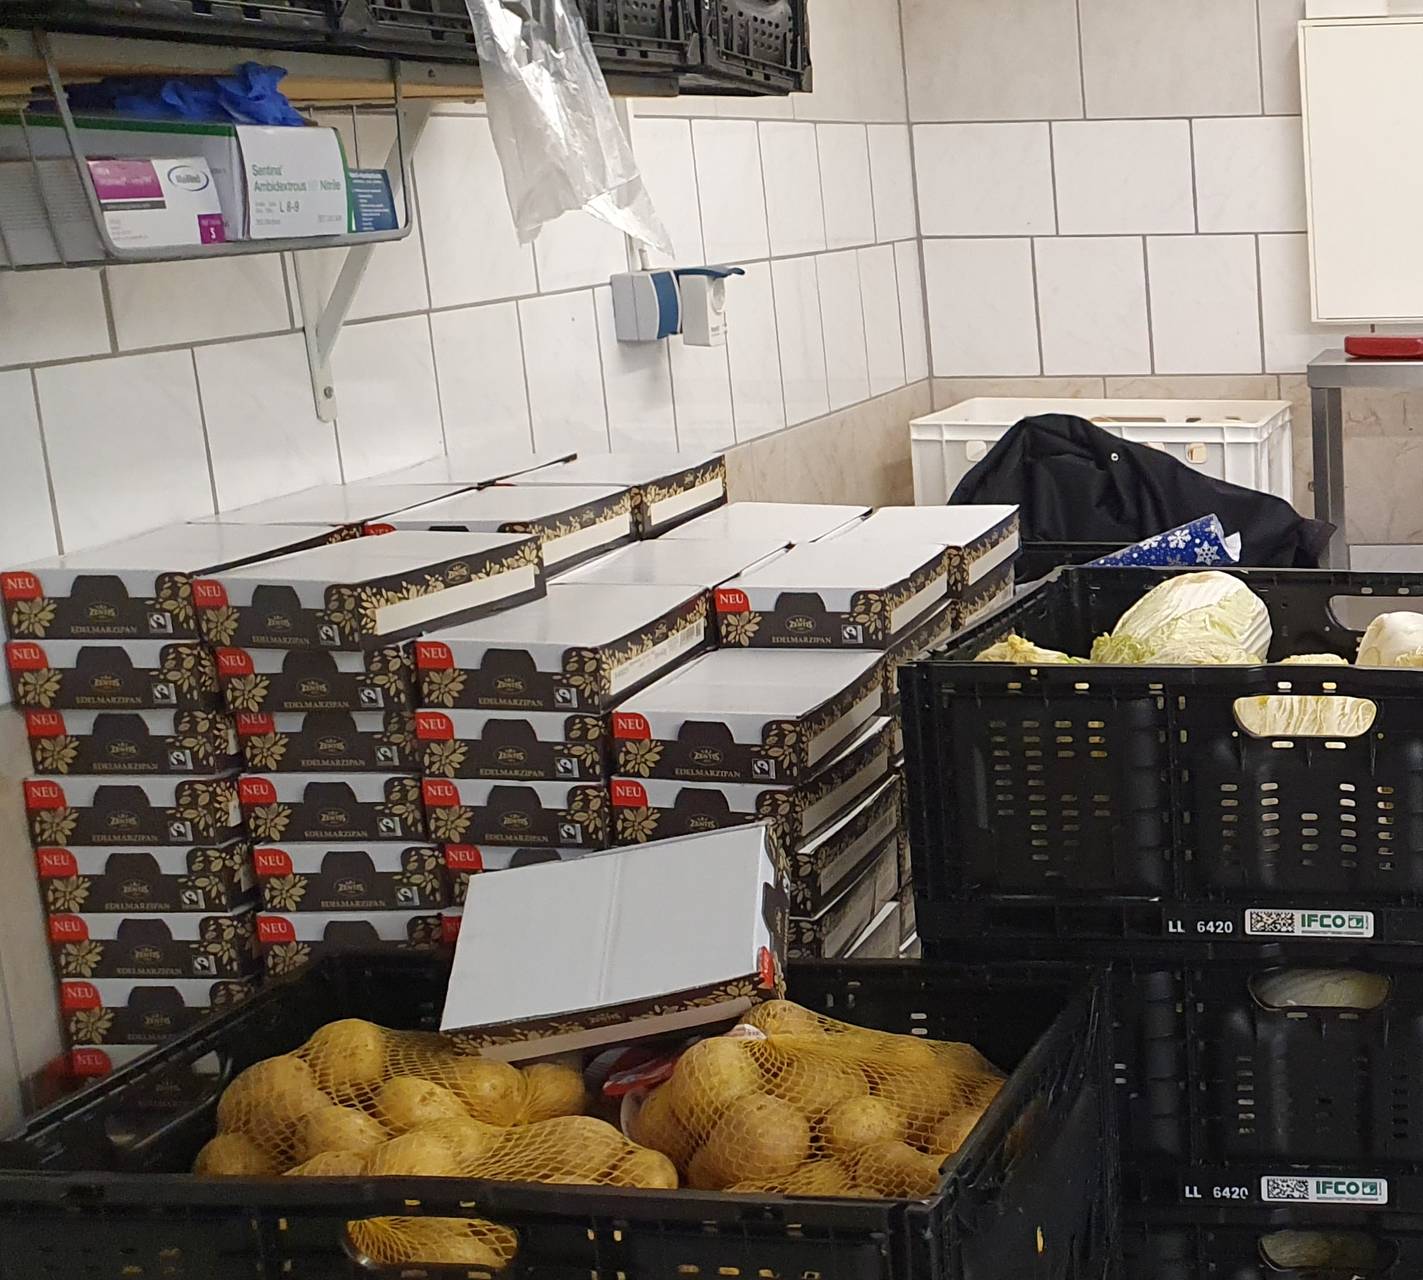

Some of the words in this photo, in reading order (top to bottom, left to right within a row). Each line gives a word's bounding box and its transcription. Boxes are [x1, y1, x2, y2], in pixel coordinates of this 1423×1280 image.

[8, 578, 35, 590] NEU
[198, 586, 221, 597] NEU
[720, 594, 744, 604] NEU
[13, 648, 40, 660] NEU
[421, 648, 448, 659] NEU
[220, 655, 246, 666] NEU
[31, 714, 58, 725] NEU
[241, 713, 268, 724] NEU
[419, 719, 446, 730] NEU
[618, 719, 645, 730] NEU
[302, 759, 366, 767] EDELMARZIPAN
[480, 769, 544, 777] EDELMARZIPAN
[31, 787, 58, 798] NEU
[243, 784, 269, 794] NEU
[428, 785, 454, 796] NEU
[616, 786, 641, 797] NEU
[43, 854, 70, 865] NEU
[258, 856, 285, 866] NEU
[449, 850, 475, 861] NEU
[54, 920, 81, 932] NEU
[1168, 920, 1185, 933] LL
[1197, 921, 1233, 933] 6420
[1301, 913, 1346, 929] IFCO
[261, 923, 288, 933] NEU
[67, 987, 94, 999] NEU
[1185, 1186, 1202, 1198] LL
[1213, 1186, 1248, 1199] 6420
[1315, 1180, 1360, 1196] IFCO
